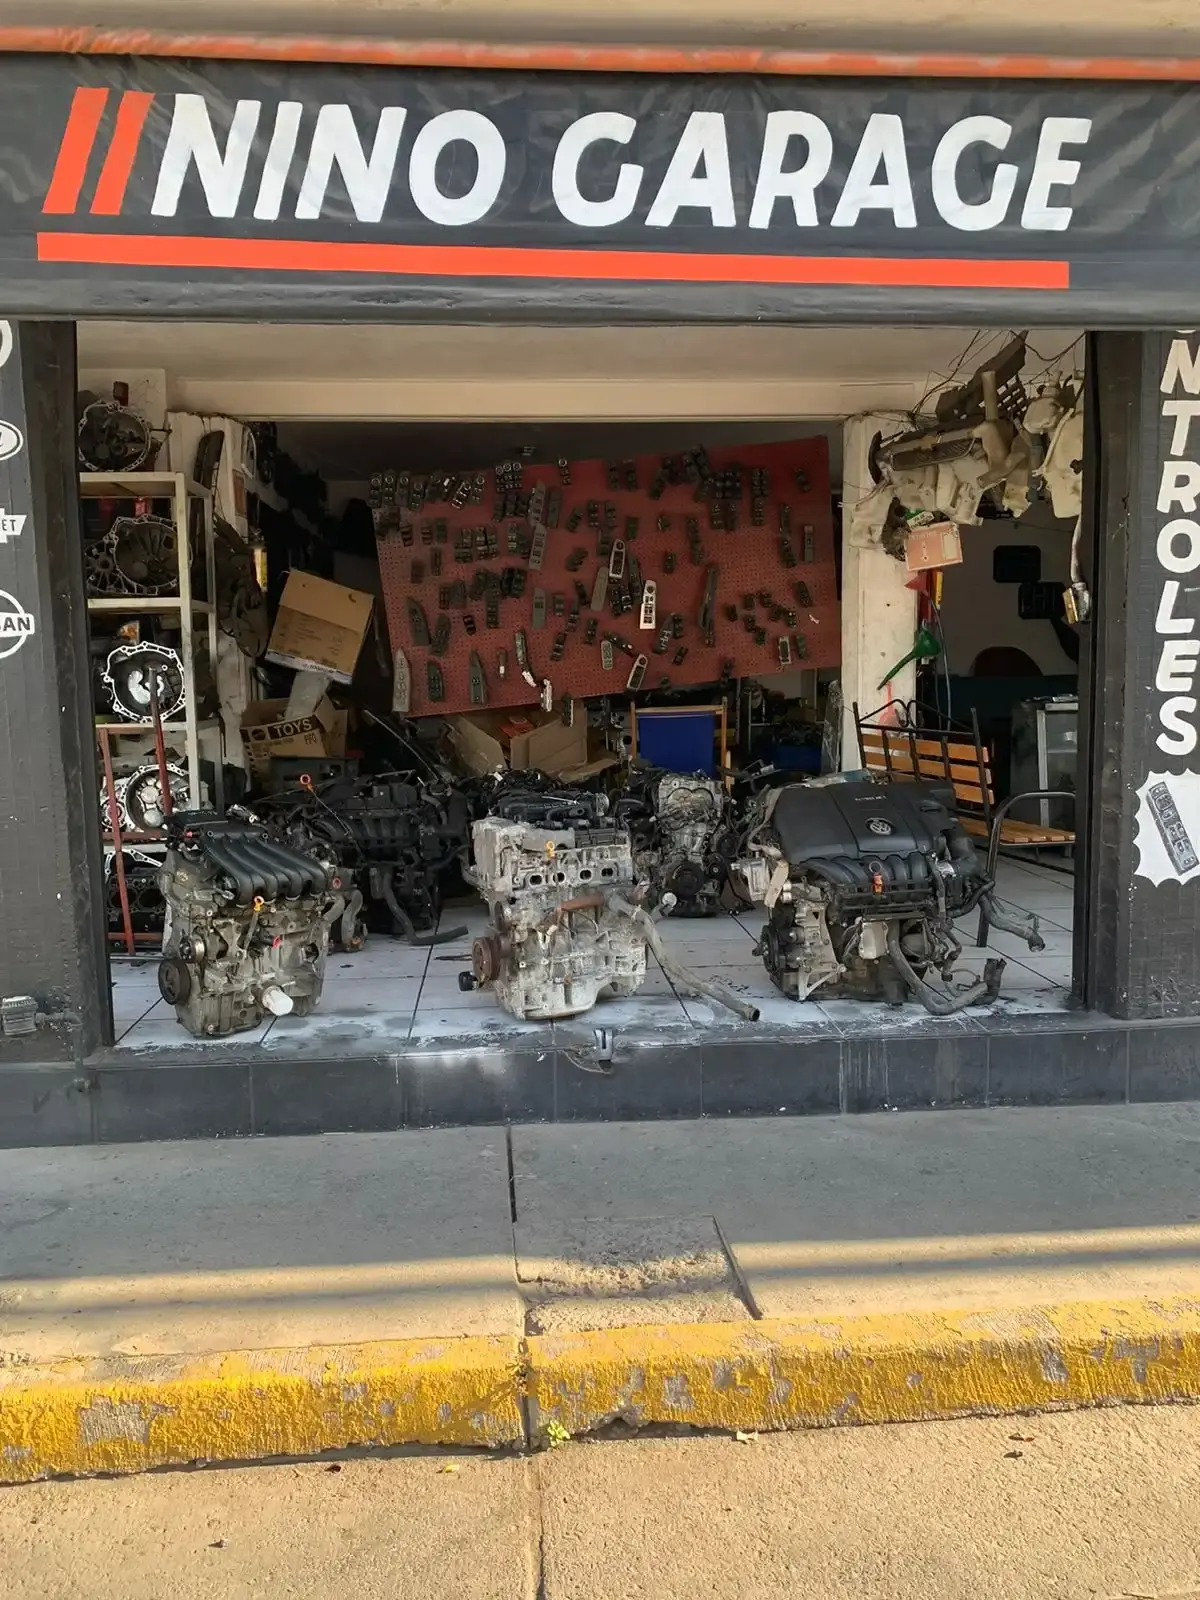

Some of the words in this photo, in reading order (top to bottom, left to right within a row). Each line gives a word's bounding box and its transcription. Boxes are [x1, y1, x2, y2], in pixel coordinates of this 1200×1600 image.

[150, 93, 507, 226] NINO
[551, 110, 1093, 231] GARAGE
[1156, 329, 1200, 756] NTROLES
[0, 617, 31, 631] AN
[273, 718, 312, 737] TOYS
